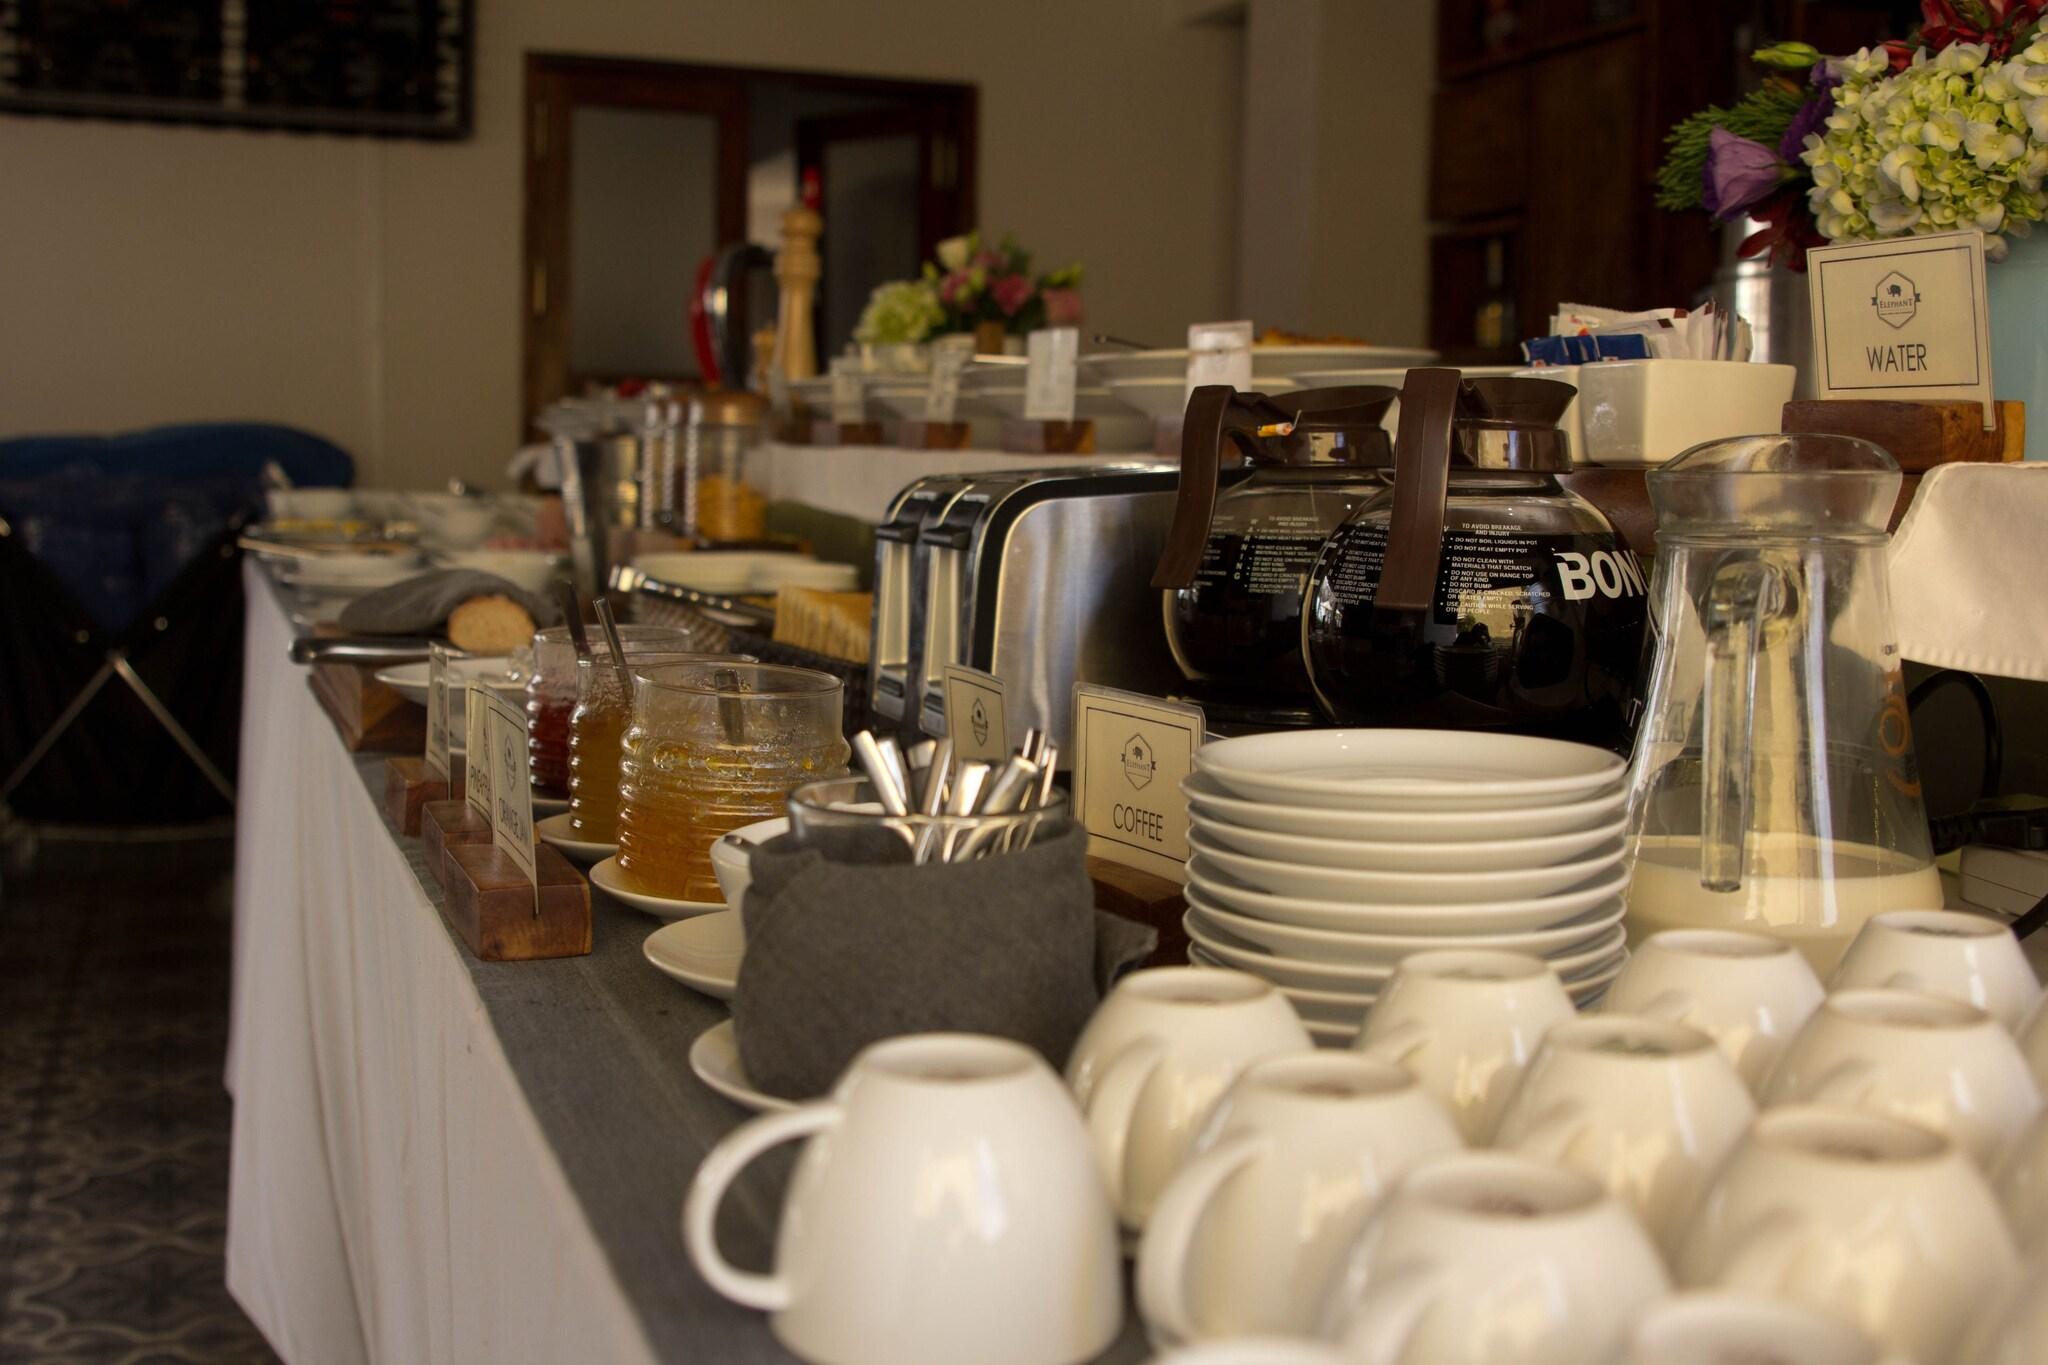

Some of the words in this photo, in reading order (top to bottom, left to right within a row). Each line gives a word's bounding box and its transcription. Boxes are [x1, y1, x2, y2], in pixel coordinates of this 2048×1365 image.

[1866, 344, 1928, 372] WATER
[1451, 562, 1486, 570] MATERIALS
[1503, 564, 1532, 572] SCRATCH
[1113, 803, 1164, 842] COFFEE
